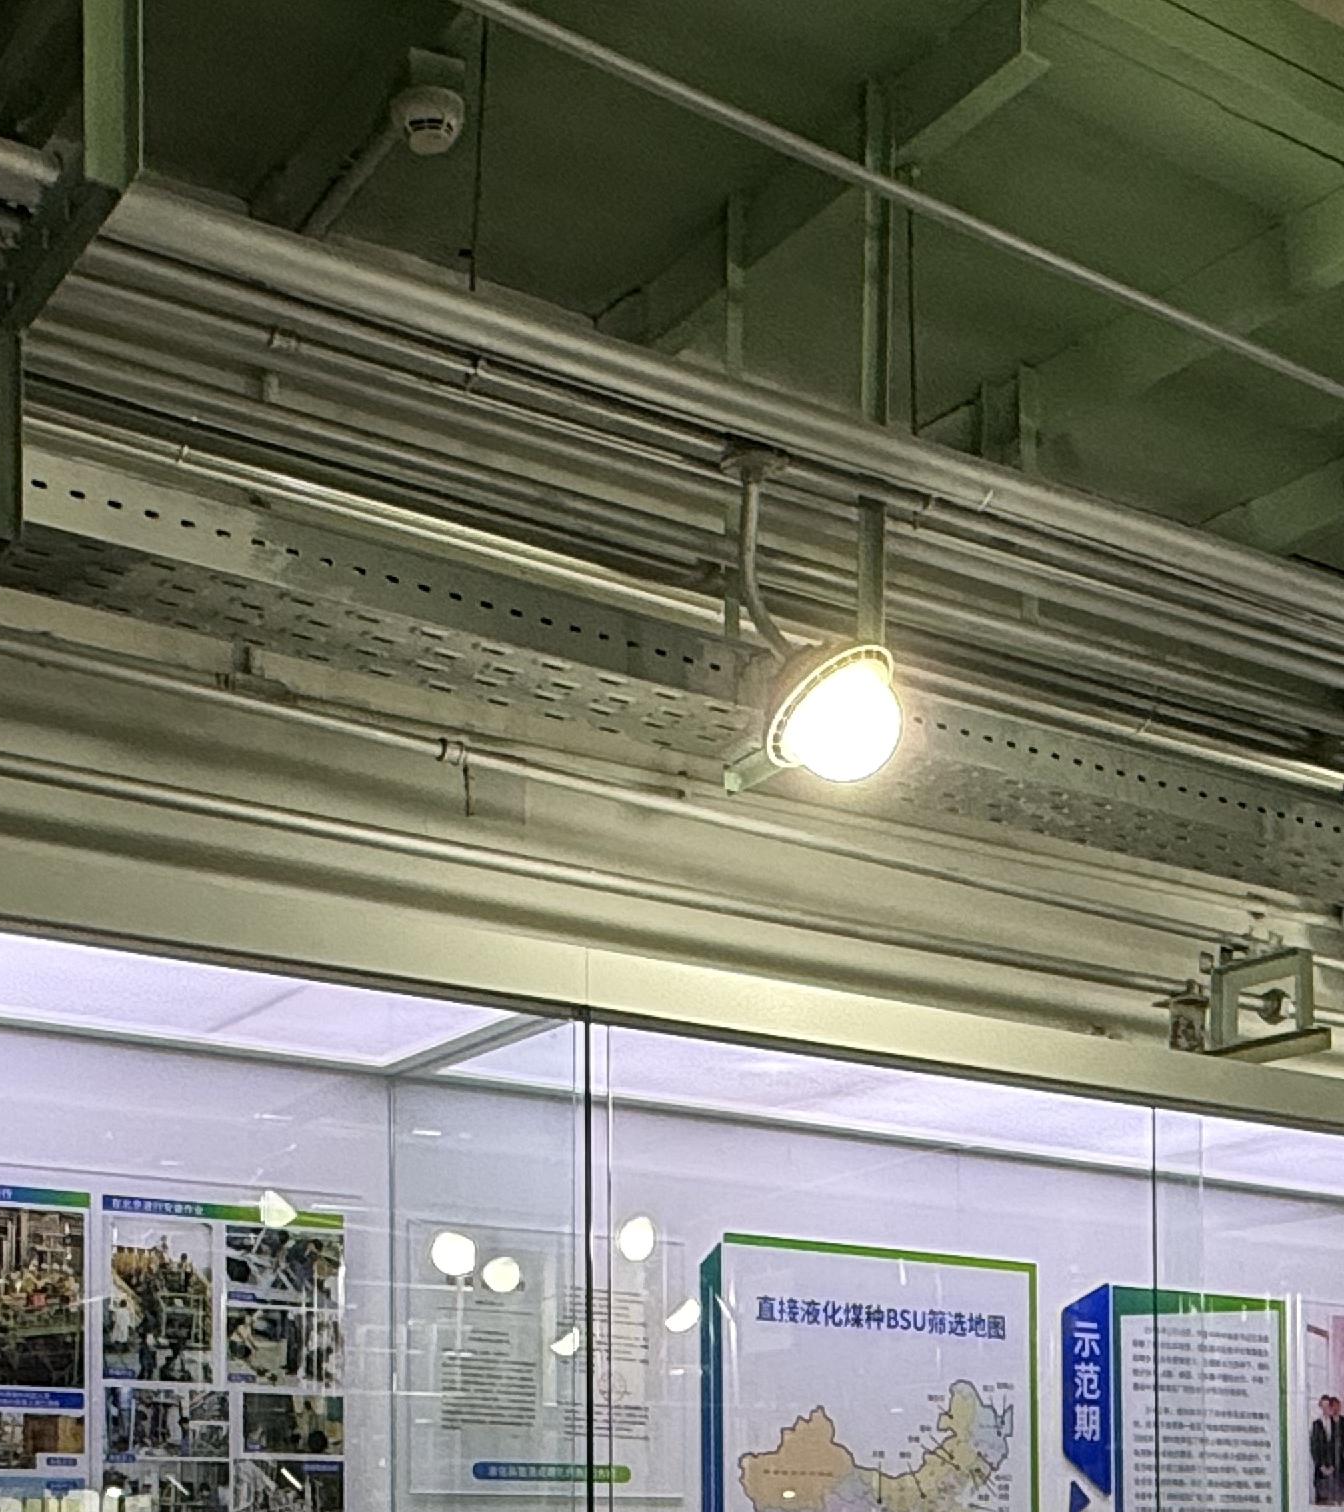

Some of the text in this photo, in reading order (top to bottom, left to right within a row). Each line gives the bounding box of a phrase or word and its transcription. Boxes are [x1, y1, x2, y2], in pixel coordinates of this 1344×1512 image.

[756, 1295, 1006, 1341] 直接液化煤种BSU筛选地图
[1072, 1320, 1102, 1442] 示范期
